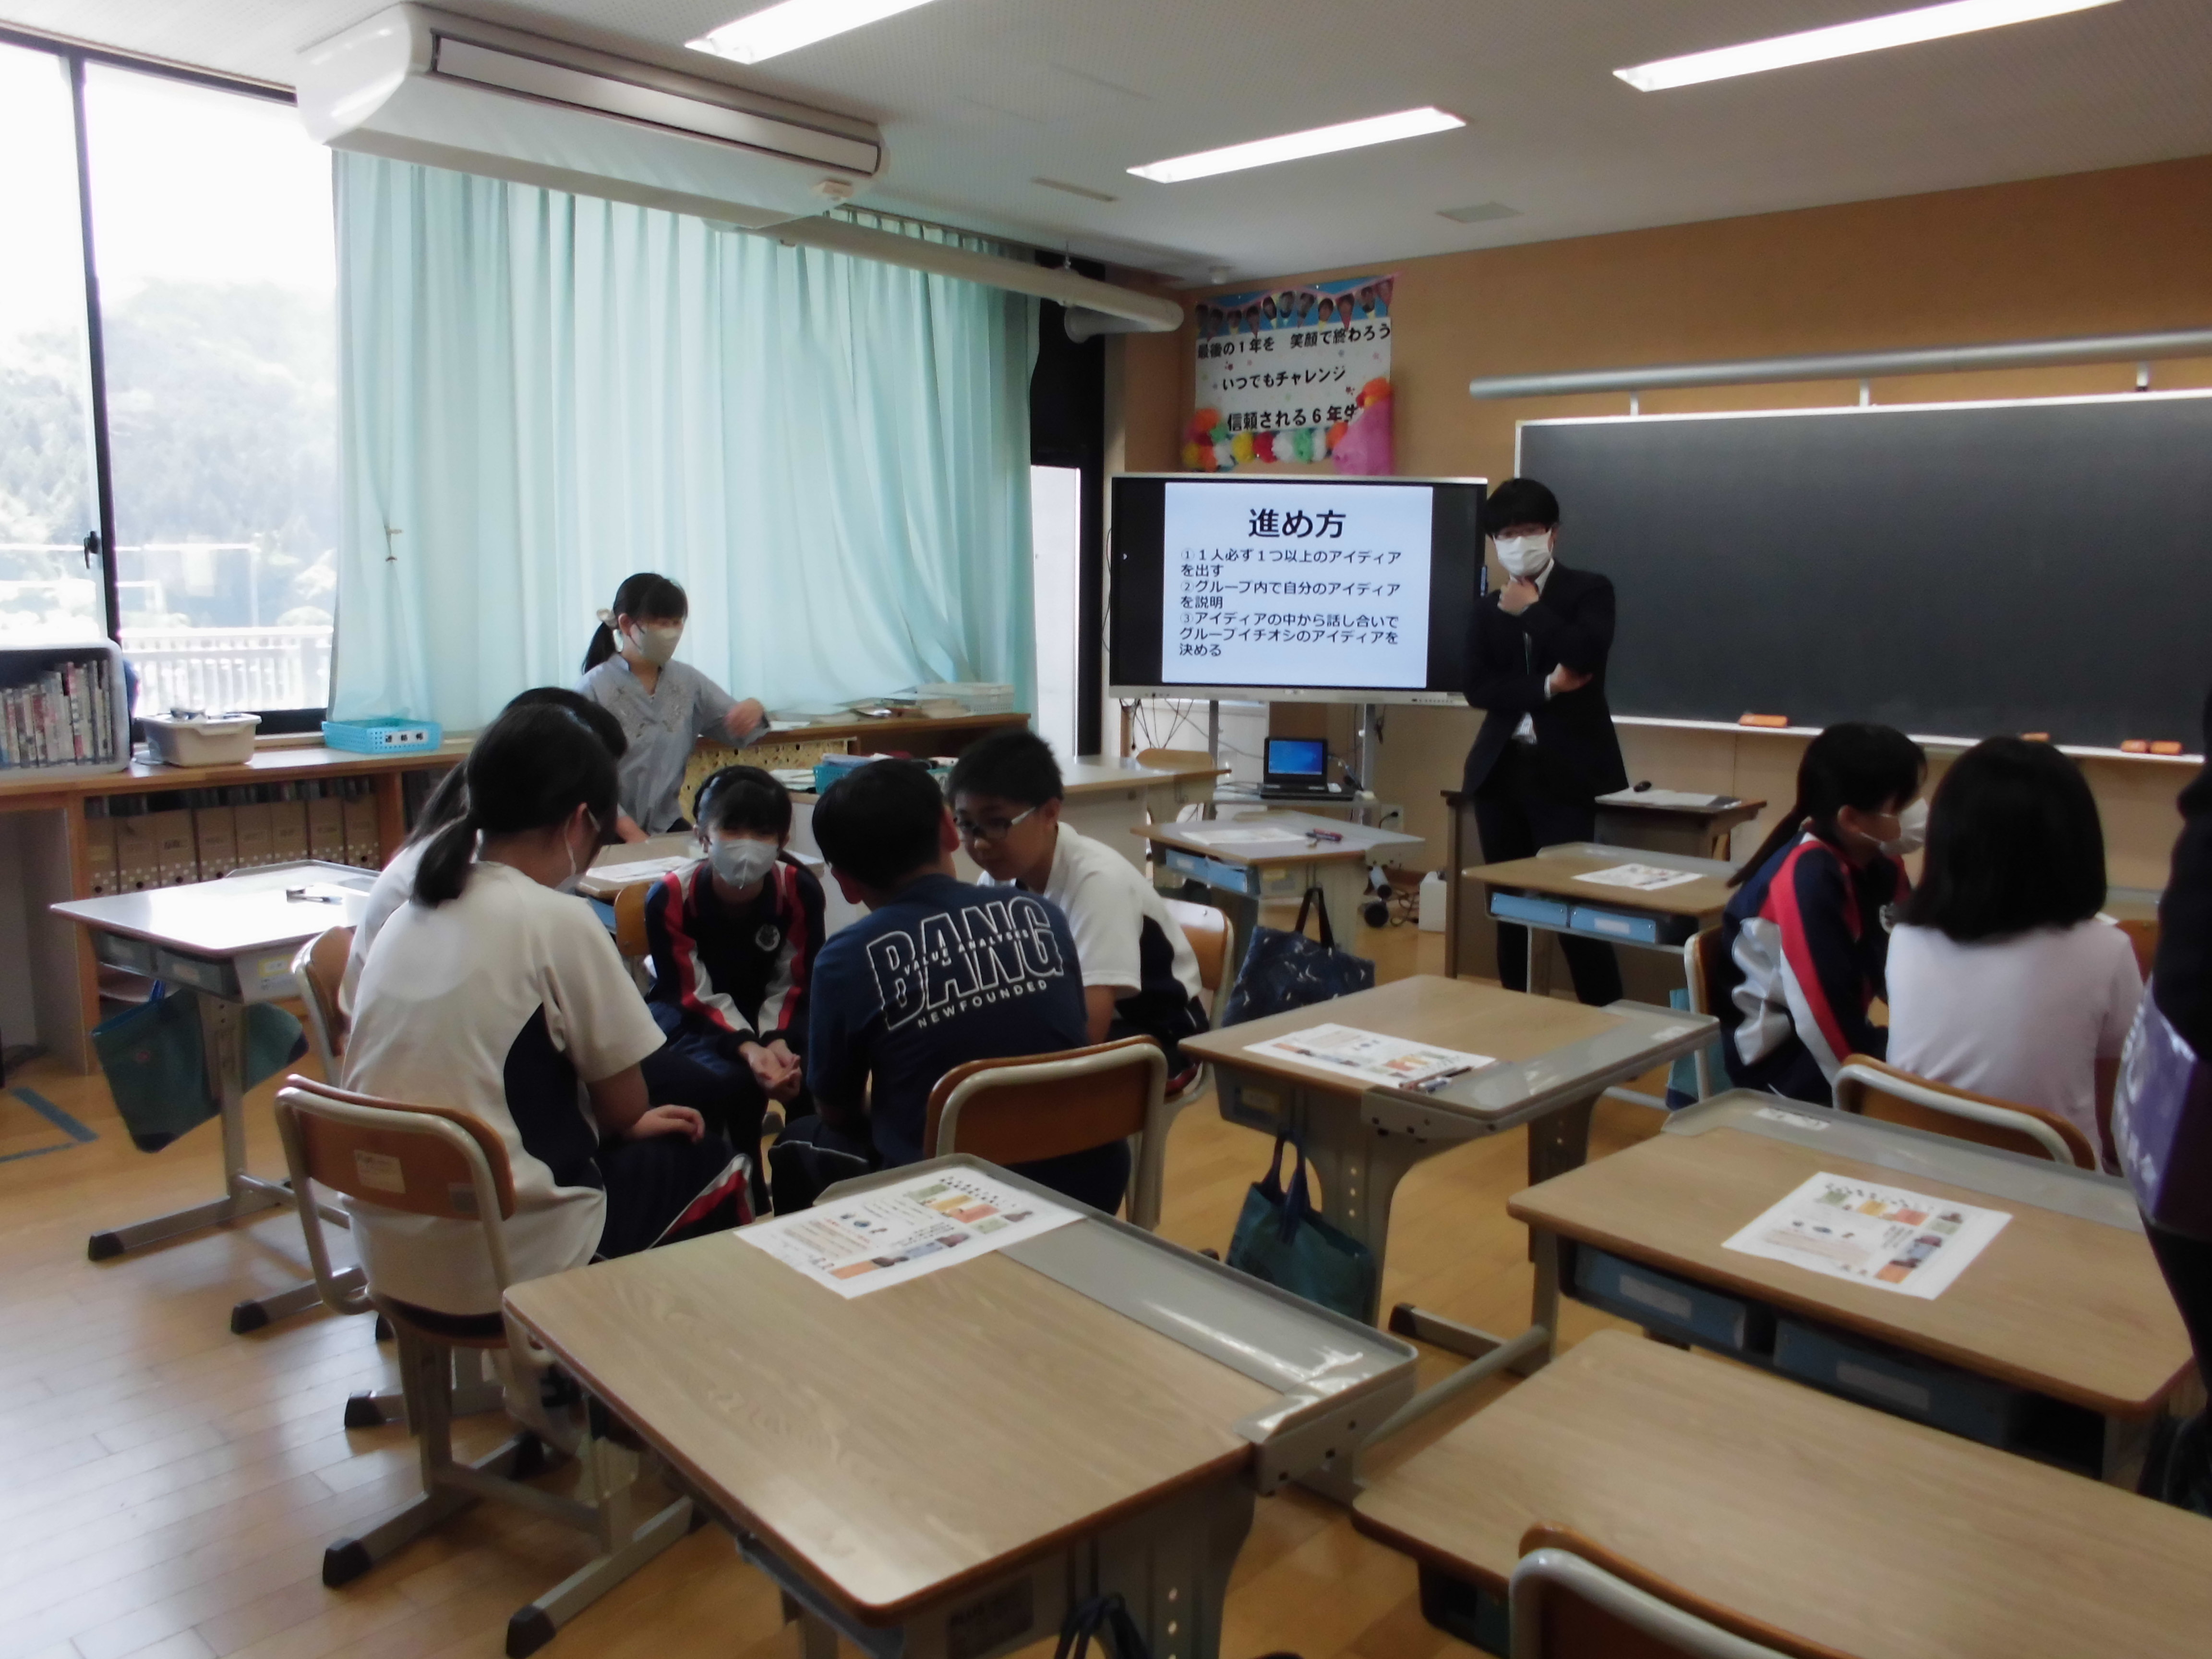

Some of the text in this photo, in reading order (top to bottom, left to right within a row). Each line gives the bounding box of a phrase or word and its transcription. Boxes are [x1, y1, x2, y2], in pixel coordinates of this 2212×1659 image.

[1290, 323, 1391, 349] 笑顔で終わろう
[1223, 365, 1346, 390] いつでもチャレンジ
[1248, 508, 1347, 539] 進め方
[1181, 564, 1224, 577] を出す
[1180, 595, 1223, 609] を説明
[1179, 627, 1399, 645] グループイチオシのアイディアを
[1179, 643, 1222, 657] 決める
[866, 896, 1064, 1030] BANG
[917, 979, 1047, 1029] NEWFOUNDED
